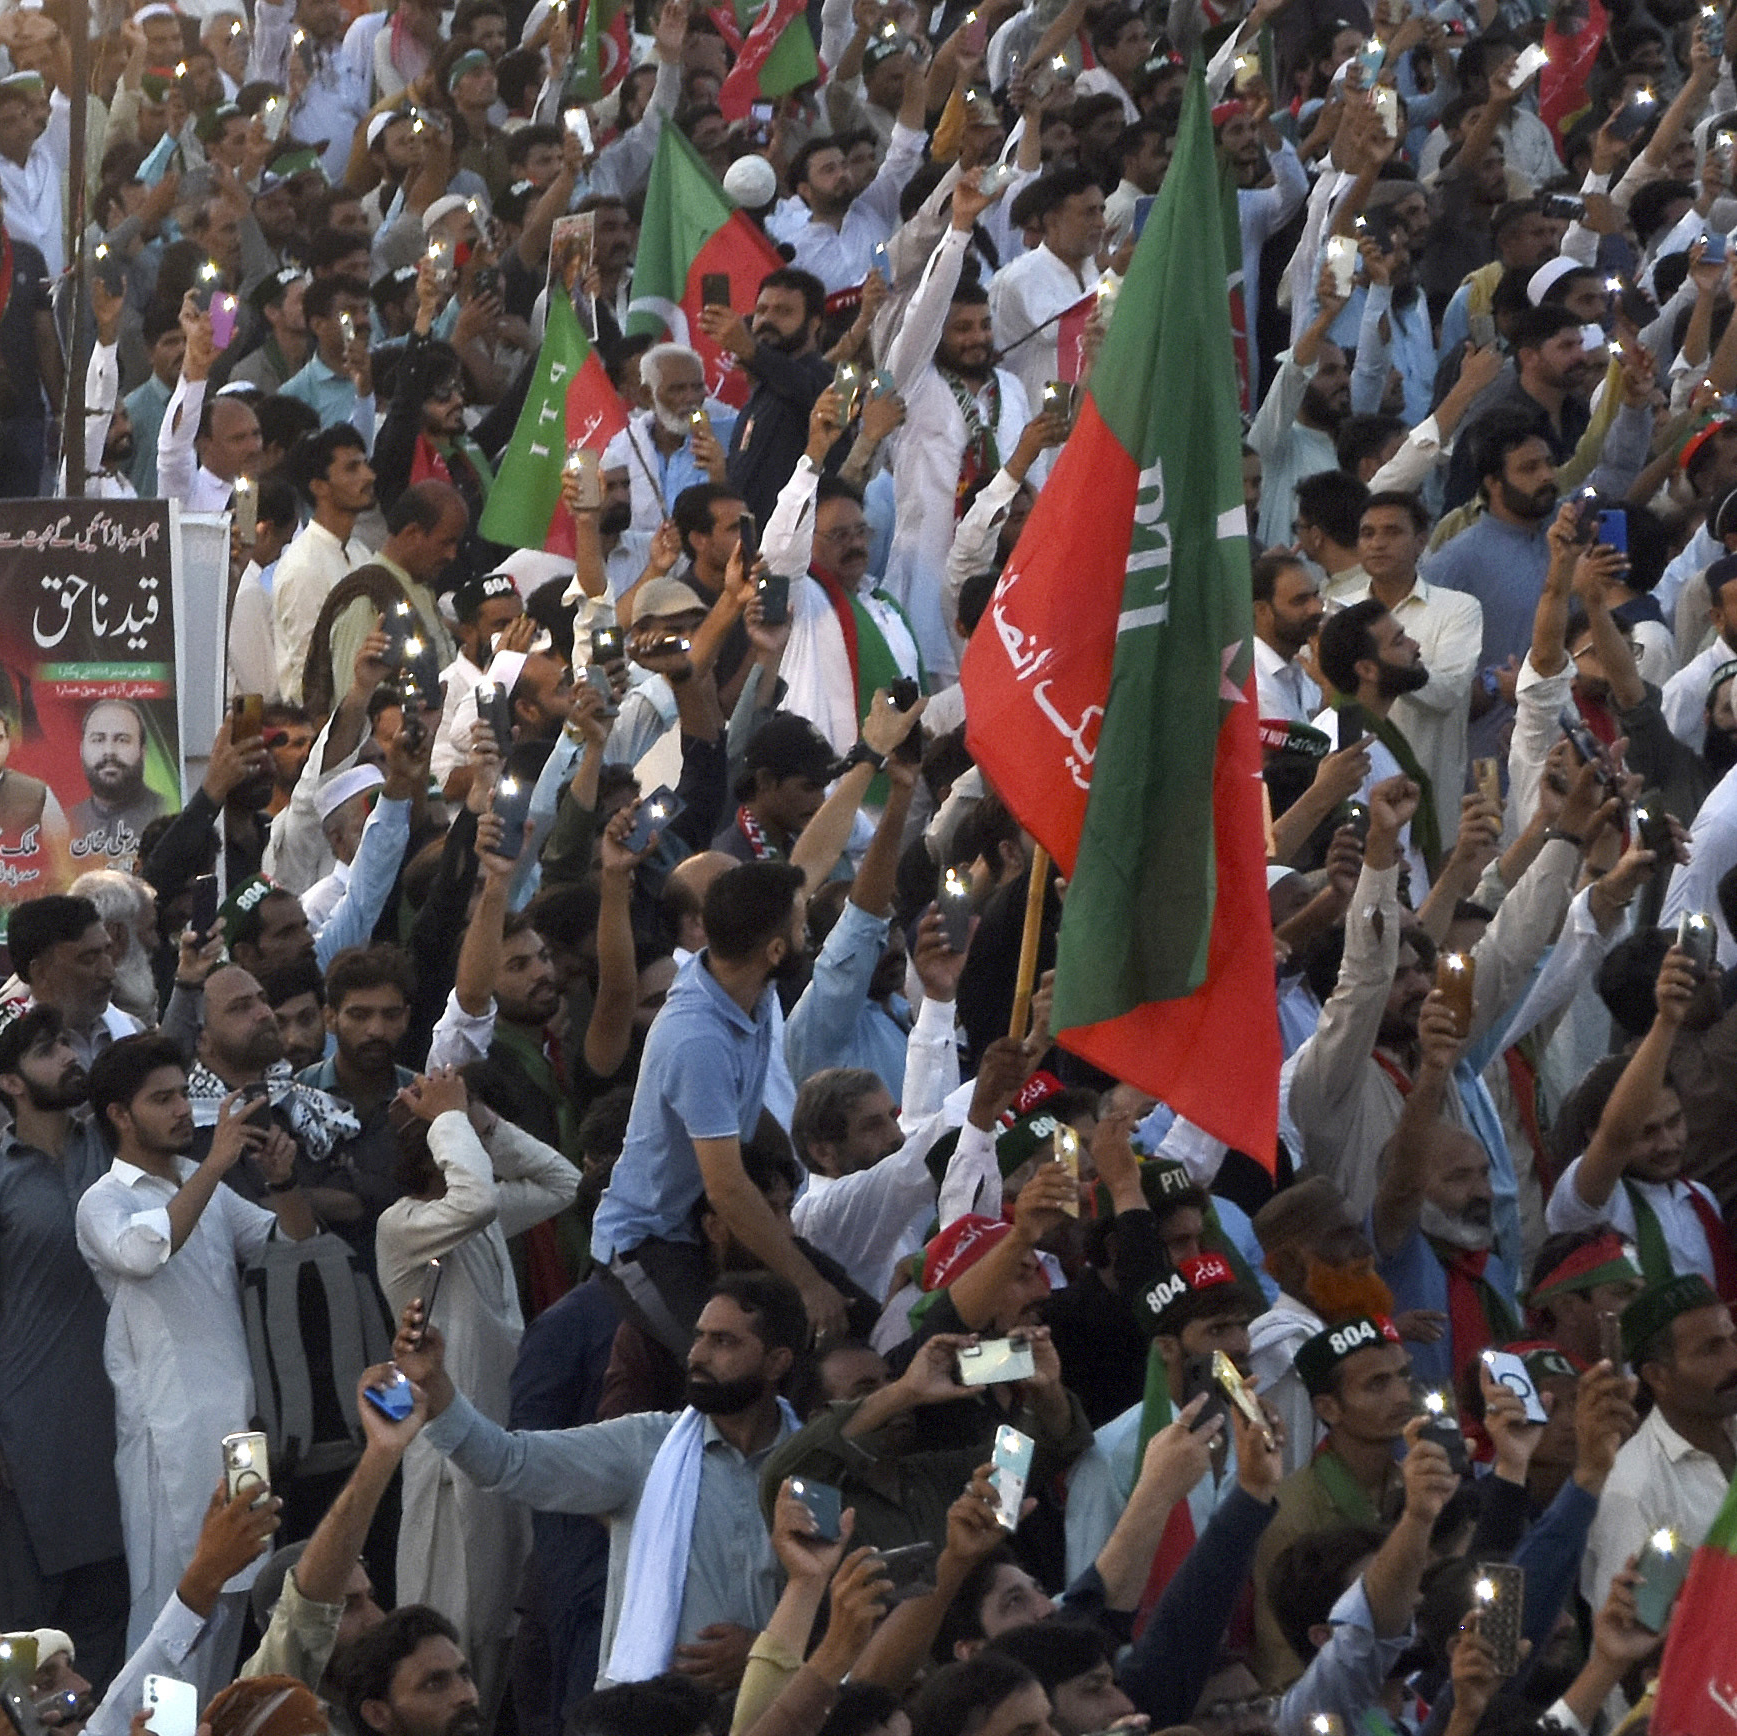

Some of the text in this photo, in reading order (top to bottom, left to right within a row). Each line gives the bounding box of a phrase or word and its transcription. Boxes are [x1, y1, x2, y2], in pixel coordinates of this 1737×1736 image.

[1117, 456, 1173, 640] PTI
[484, 575, 513, 596] 804
[109, 576, 160, 650] قید
[0, 824, 40, 857] ملک
[236, 881, 269, 911] 804
[1160, 1168, 1191, 1194] PTI
[1146, 1273, 1187, 1313] 804
[1328, 1320, 1377, 1355] 804
